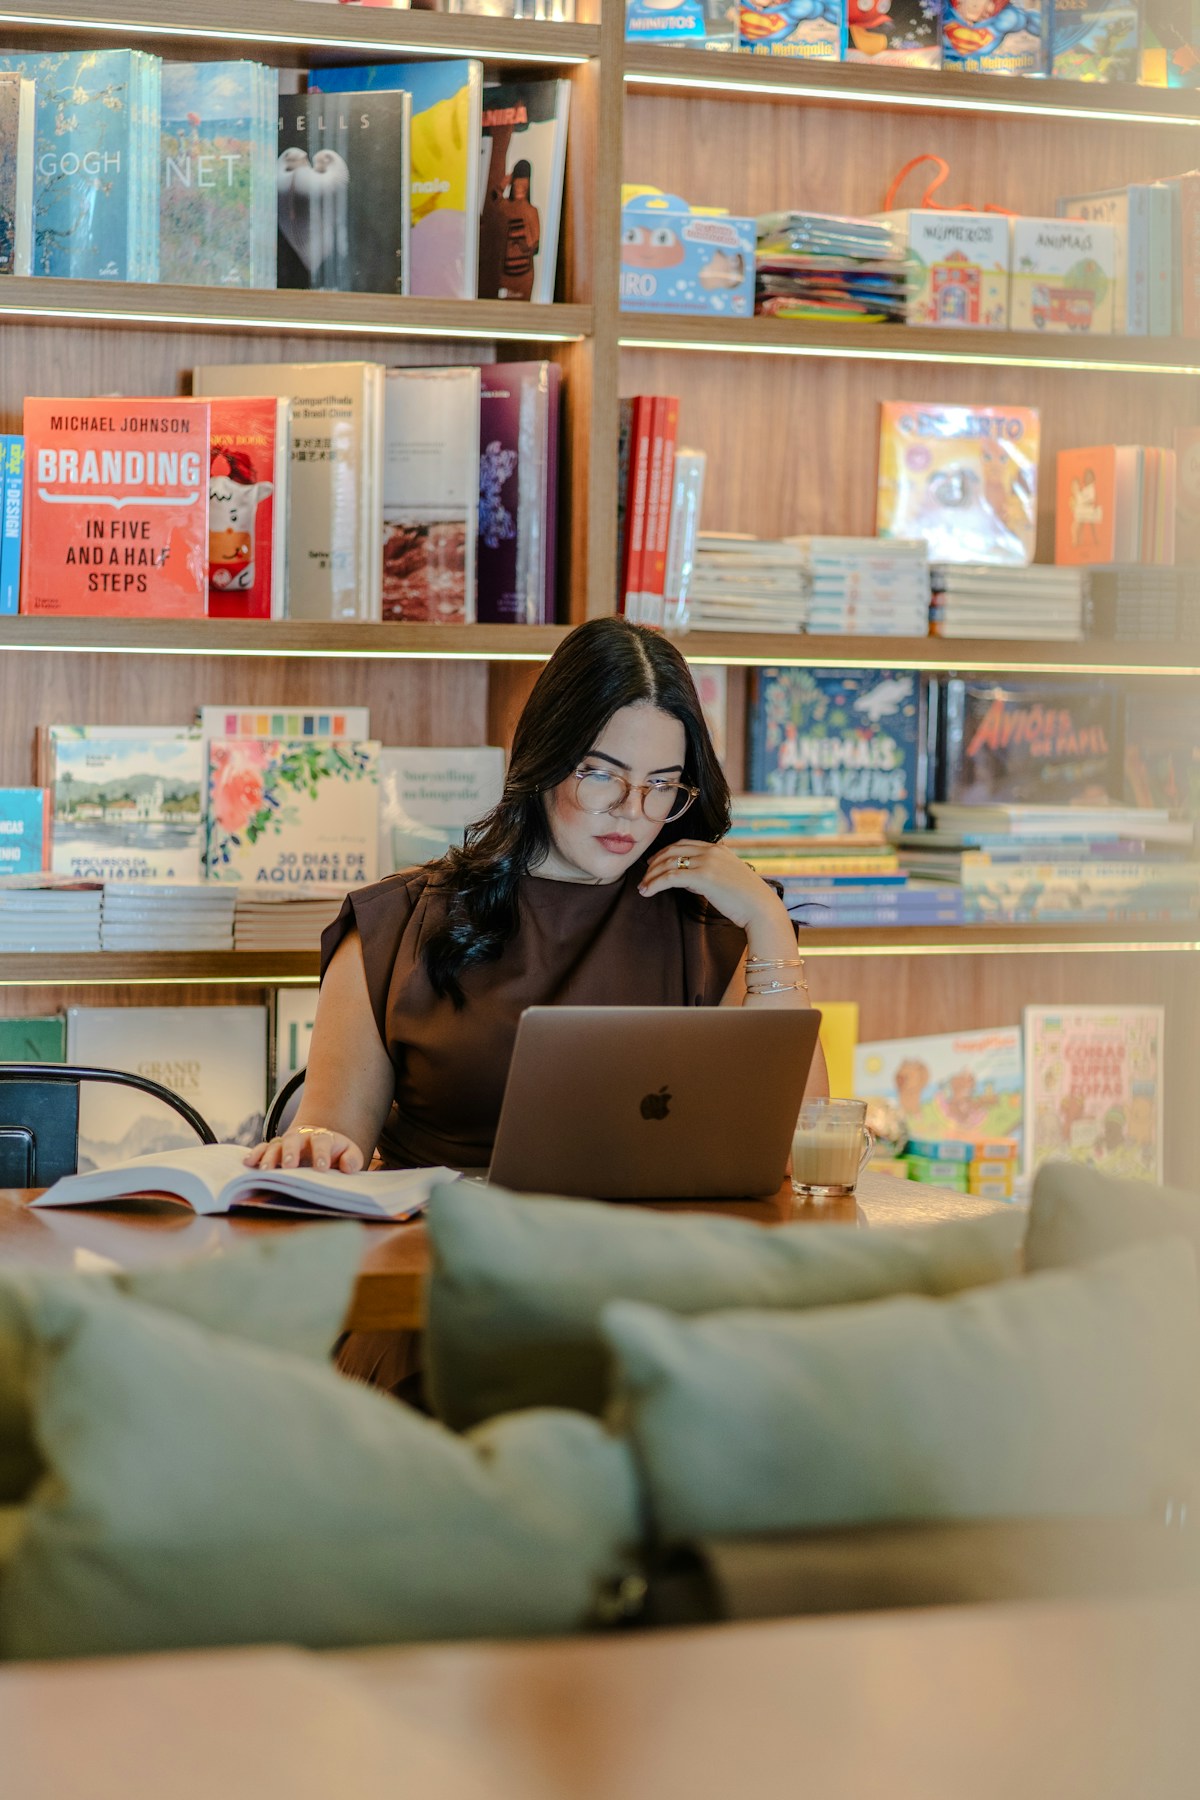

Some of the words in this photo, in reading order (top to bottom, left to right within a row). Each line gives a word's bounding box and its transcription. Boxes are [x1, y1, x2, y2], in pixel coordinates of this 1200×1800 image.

[629, 16, 696, 30] MINUTOS
[39, 150, 121, 176] GOGH
[165, 155, 241, 188] NET
[50, 416, 115, 431] MICHAEL
[120, 418, 190, 433] JOHNSON
[38, 449, 200, 486] BRANDING
[5, 489, 21, 538] DESIGN
[86, 520, 104, 538] IN
[111, 521, 150, 539] FIVE
[66, 547, 103, 565] AND
[109, 547, 120, 565] A
[124, 548, 170, 566] HALF
[88, 573, 147, 592] STEPS
[279, 853, 297, 865] 30
[303, 853, 339, 865] DIAS
[347, 853, 365, 865] DE
[257, 867, 365, 882] AQUARELA
[138, 1060, 200, 1075] GRAND
